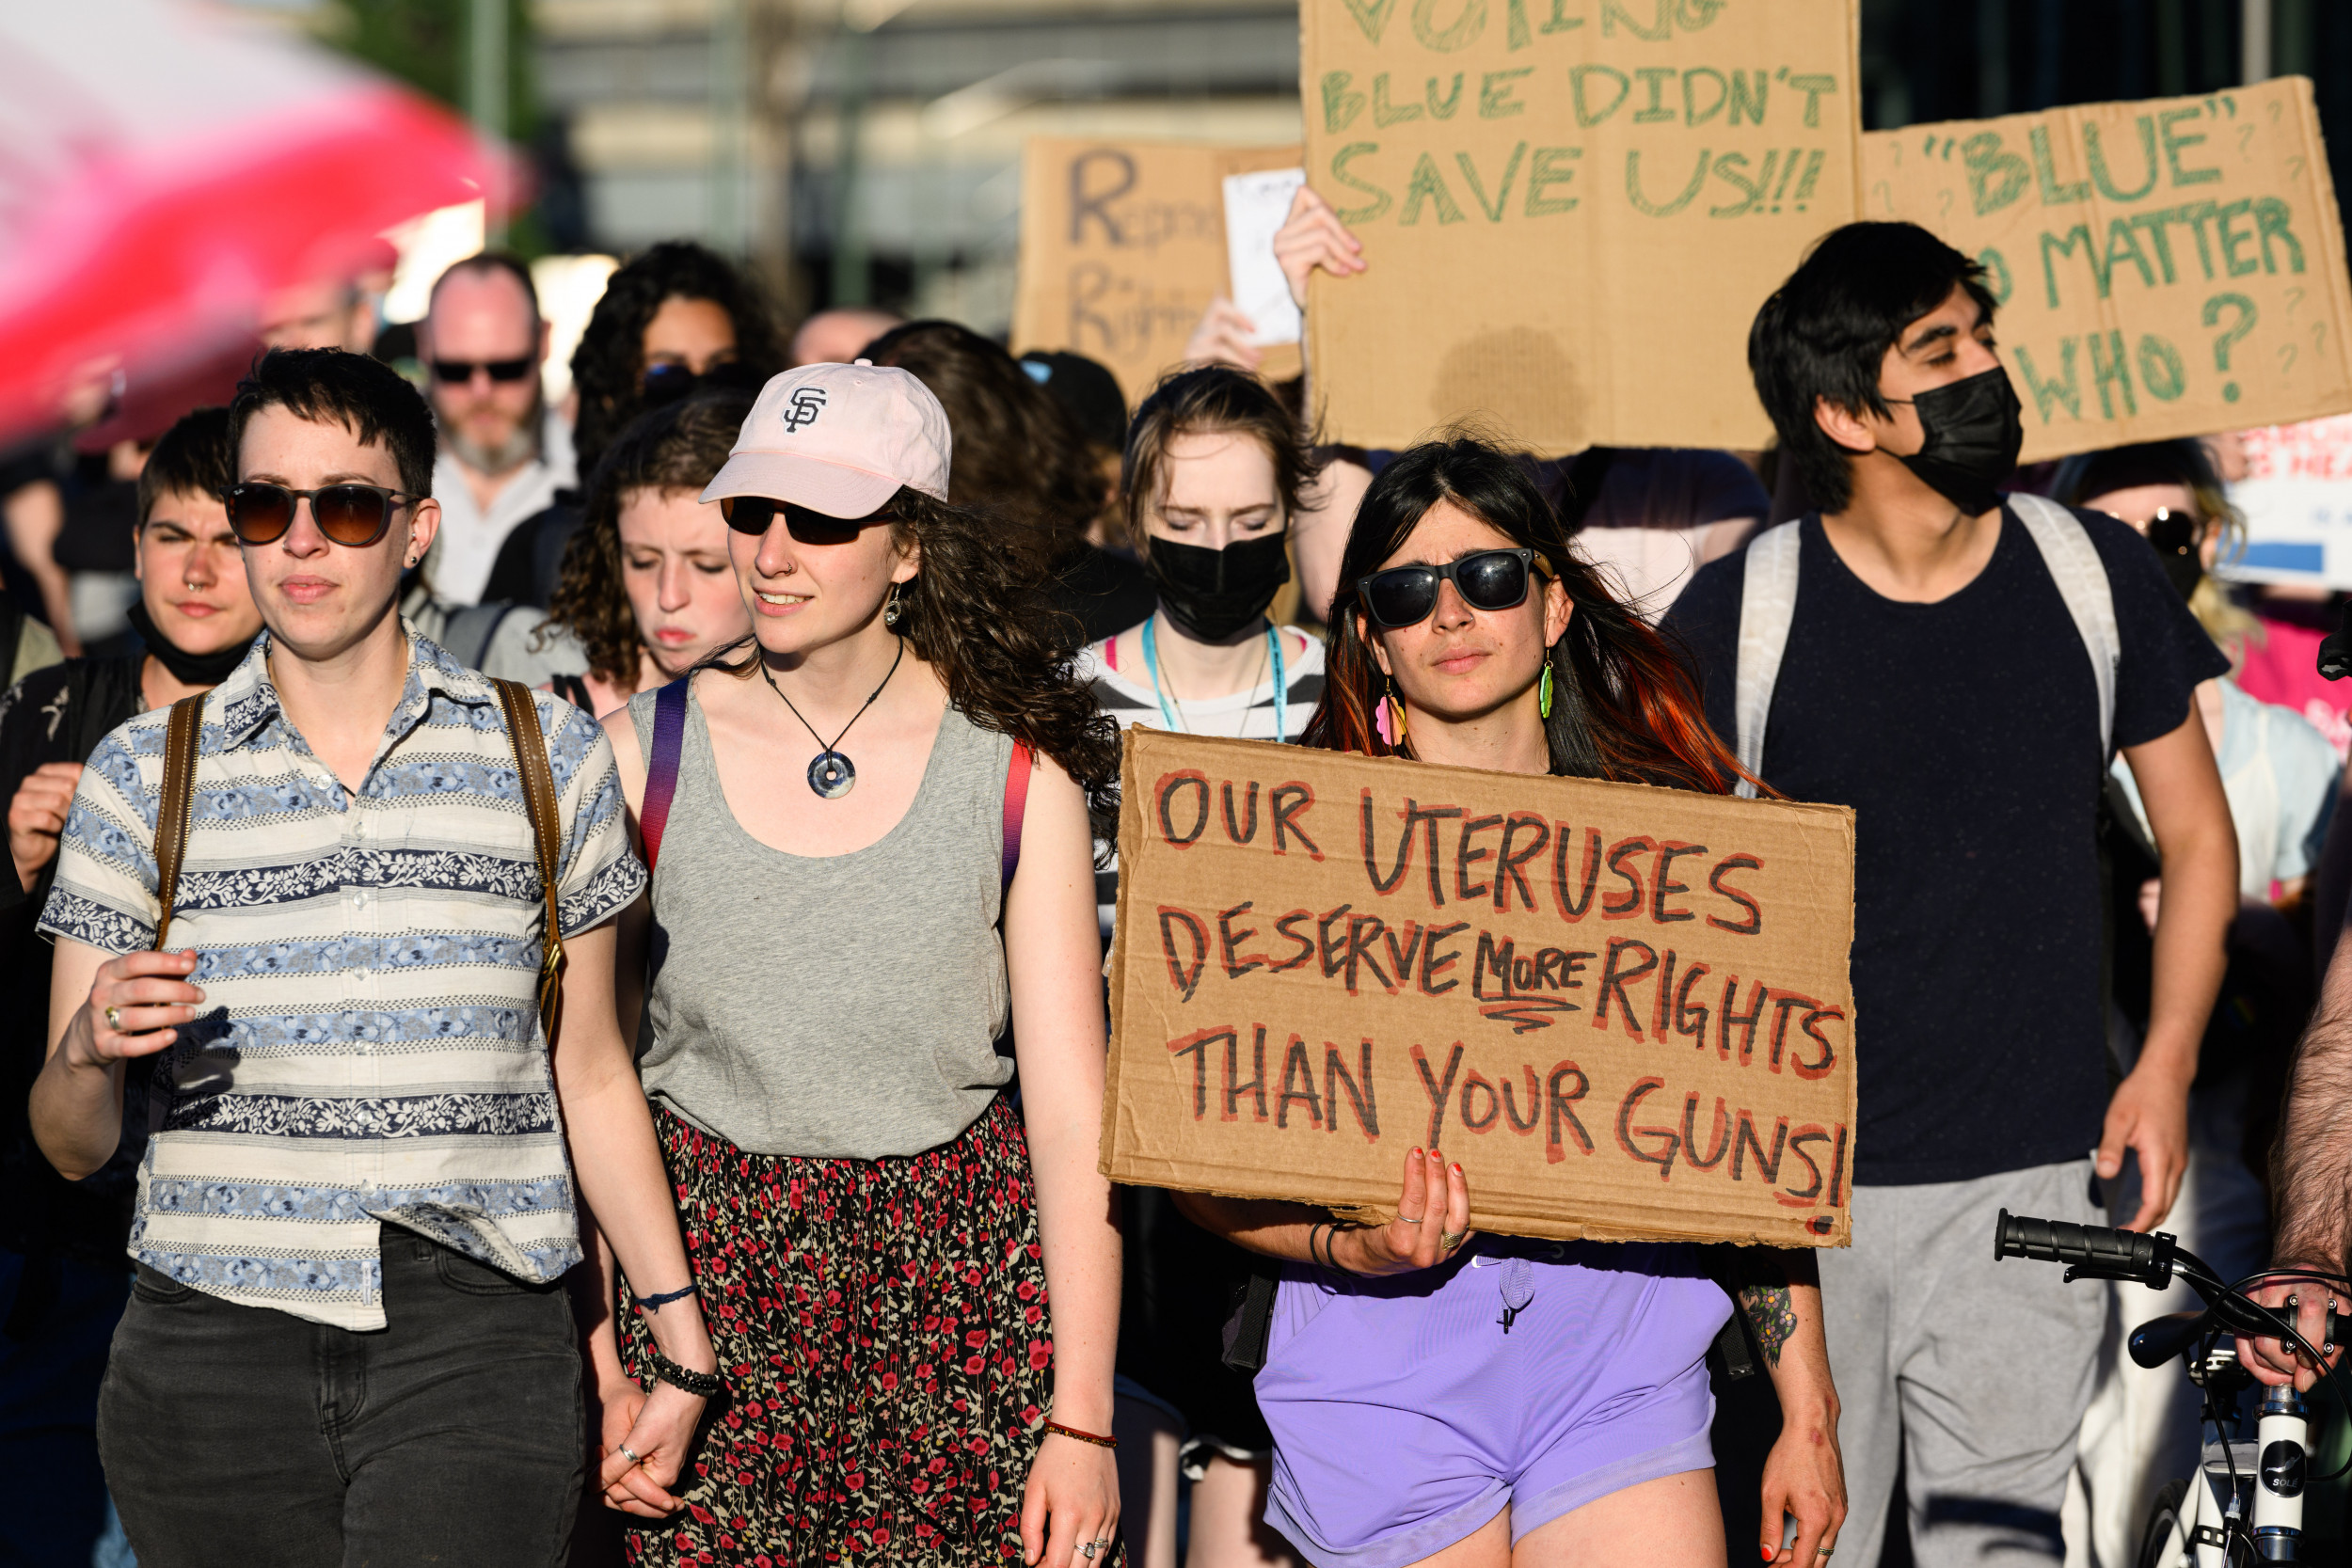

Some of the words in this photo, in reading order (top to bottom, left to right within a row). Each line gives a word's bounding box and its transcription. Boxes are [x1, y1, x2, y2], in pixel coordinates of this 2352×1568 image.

[1321, 66, 1534, 135] BLUE
[1568, 64, 1837, 128] DIDN'T
[1330, 141, 1582, 226] SAVE
[1626, 148, 1826, 218] US!!!
[2039, 197, 2307, 309] MATTER
[784, 388, 826, 433] SF
[2013, 293, 2258, 425] WHO?
[1155, 768, 1325, 862] OUR
[1359, 786, 1765, 936] UTERUSES
[1156, 901, 1470, 1004] DESERVE
[1471, 932, 1597, 1002] MORE
[1592, 936, 1847, 1080] RIGHTS
[1167, 1024, 1379, 1144] THAN
[1408, 1041, 1596, 1164] YOUR
[1614, 1076, 1849, 1236] GUNS!
